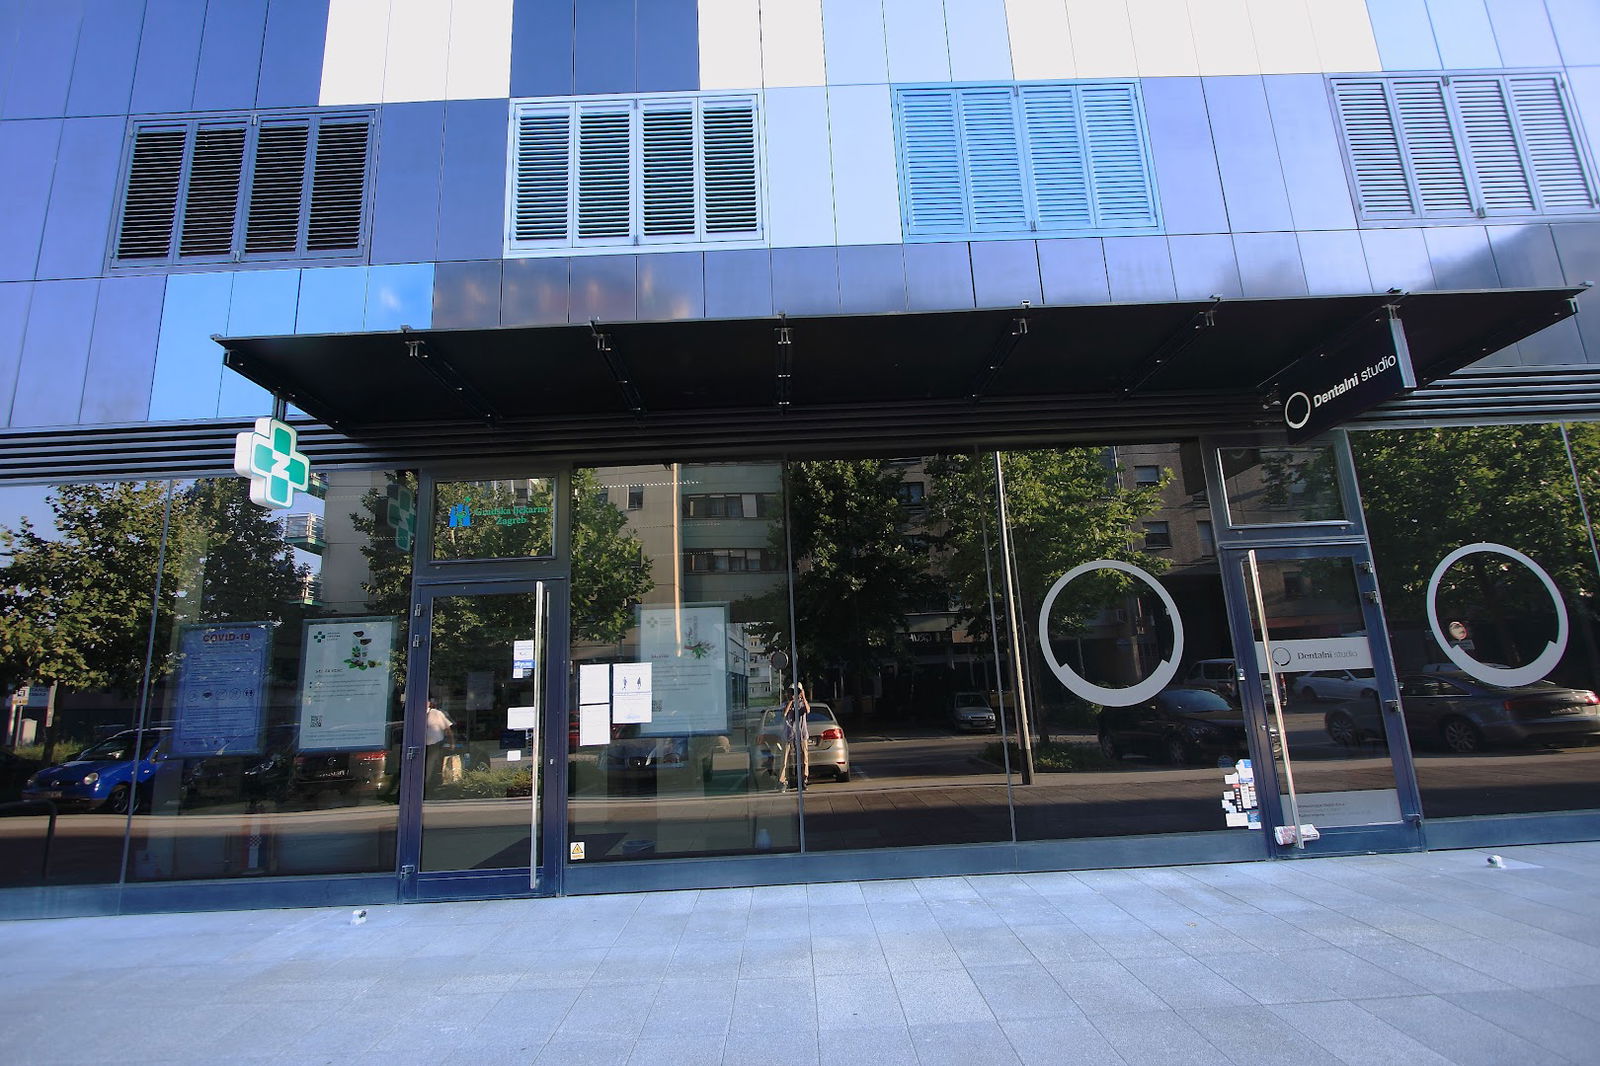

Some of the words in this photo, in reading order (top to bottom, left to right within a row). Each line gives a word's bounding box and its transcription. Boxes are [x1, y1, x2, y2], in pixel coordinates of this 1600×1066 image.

[1313, 373, 1360, 408] Dentalni
[1360, 355, 1396, 382] studio
[474, 506, 511, 515] Gradska
[496, 516, 528, 526] Zagreb
[203, 632, 251, 643] COVID-19
[1297, 650, 1333, 660] Dentalni
